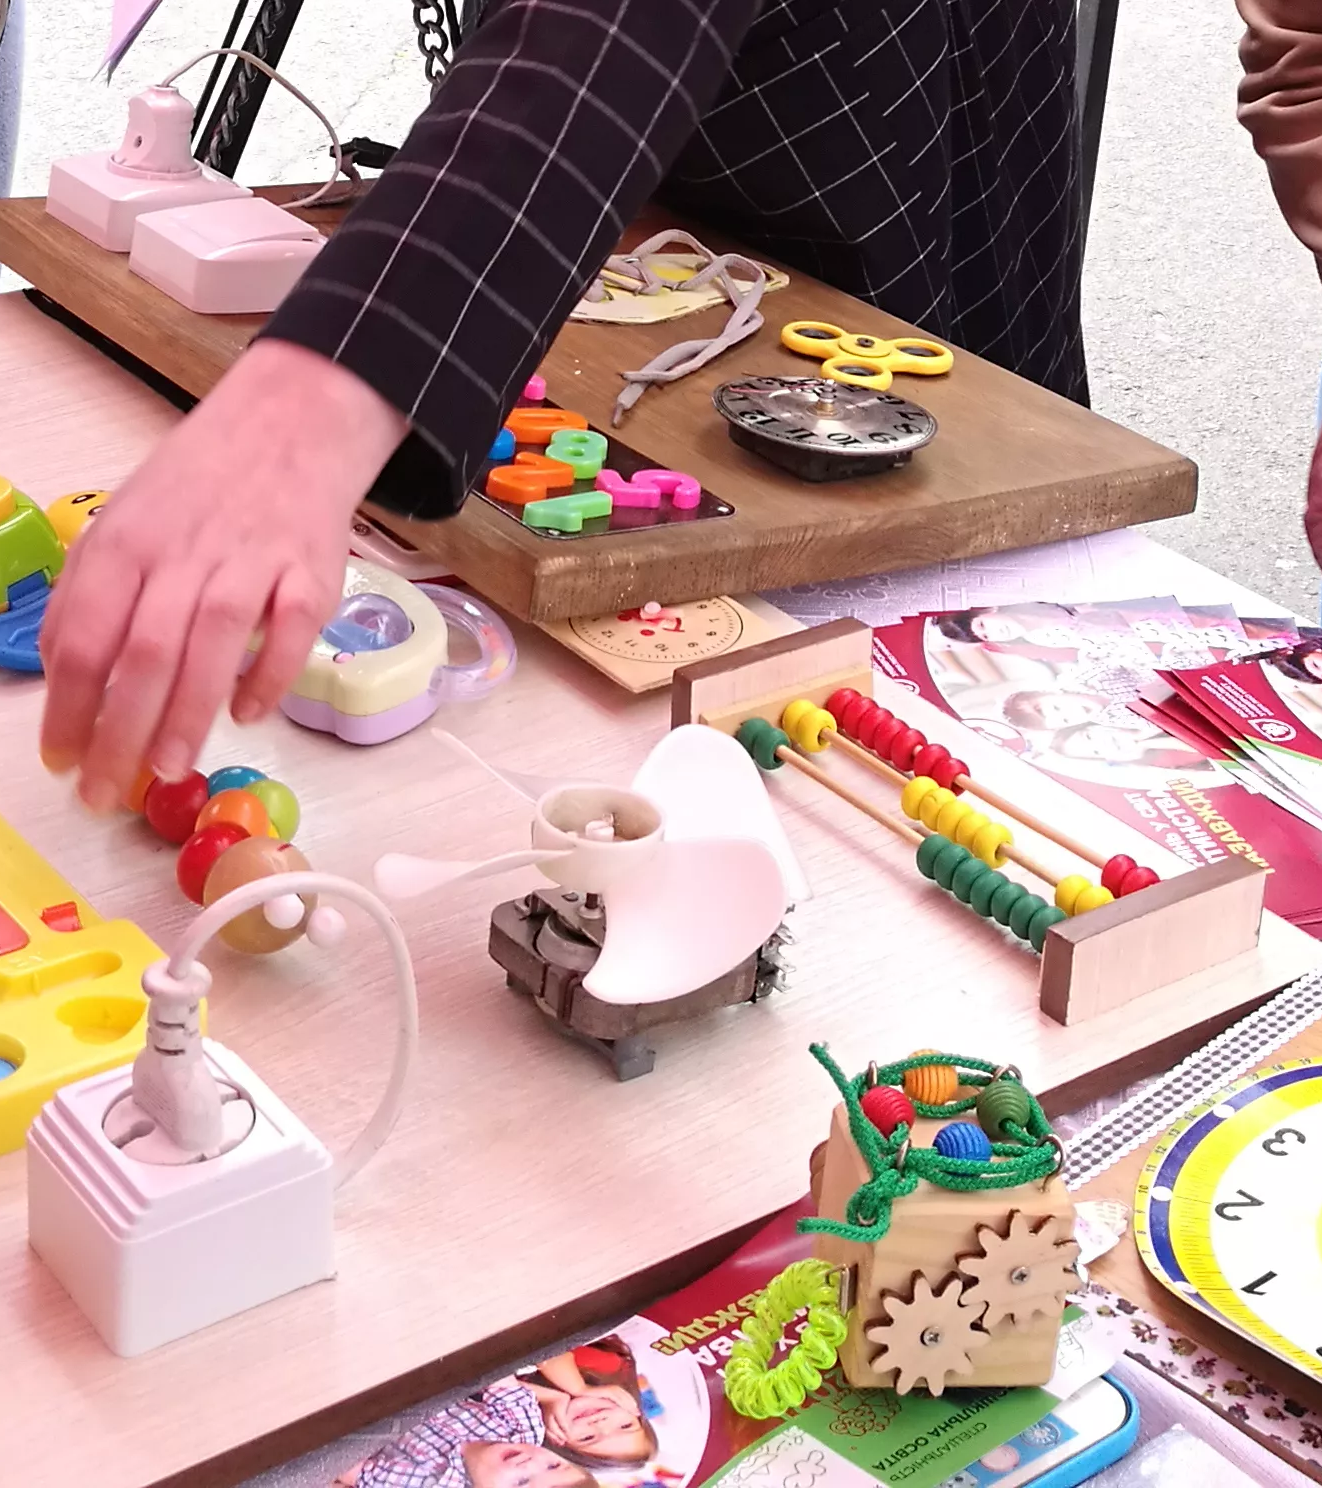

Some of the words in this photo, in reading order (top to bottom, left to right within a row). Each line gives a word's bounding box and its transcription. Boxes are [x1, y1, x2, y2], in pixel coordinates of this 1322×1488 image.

[738, 410, 781, 426] 12
[893, 422, 923, 435] 8
[785, 427, 818, 440] 11
[826, 431, 863, 446] 10
[867, 431, 898, 445] 9
[544, 428, 609, 480] 8
[1261, 1127, 1307, 1158] 3
[1213, 1187, 1266, 1223] 2
[1240, 1269, 1279, 1297] 1
[927, 1388, 1009, 1438] ШКІЛЬНА
[872, 1435, 930, 1472] ОСВІТА
